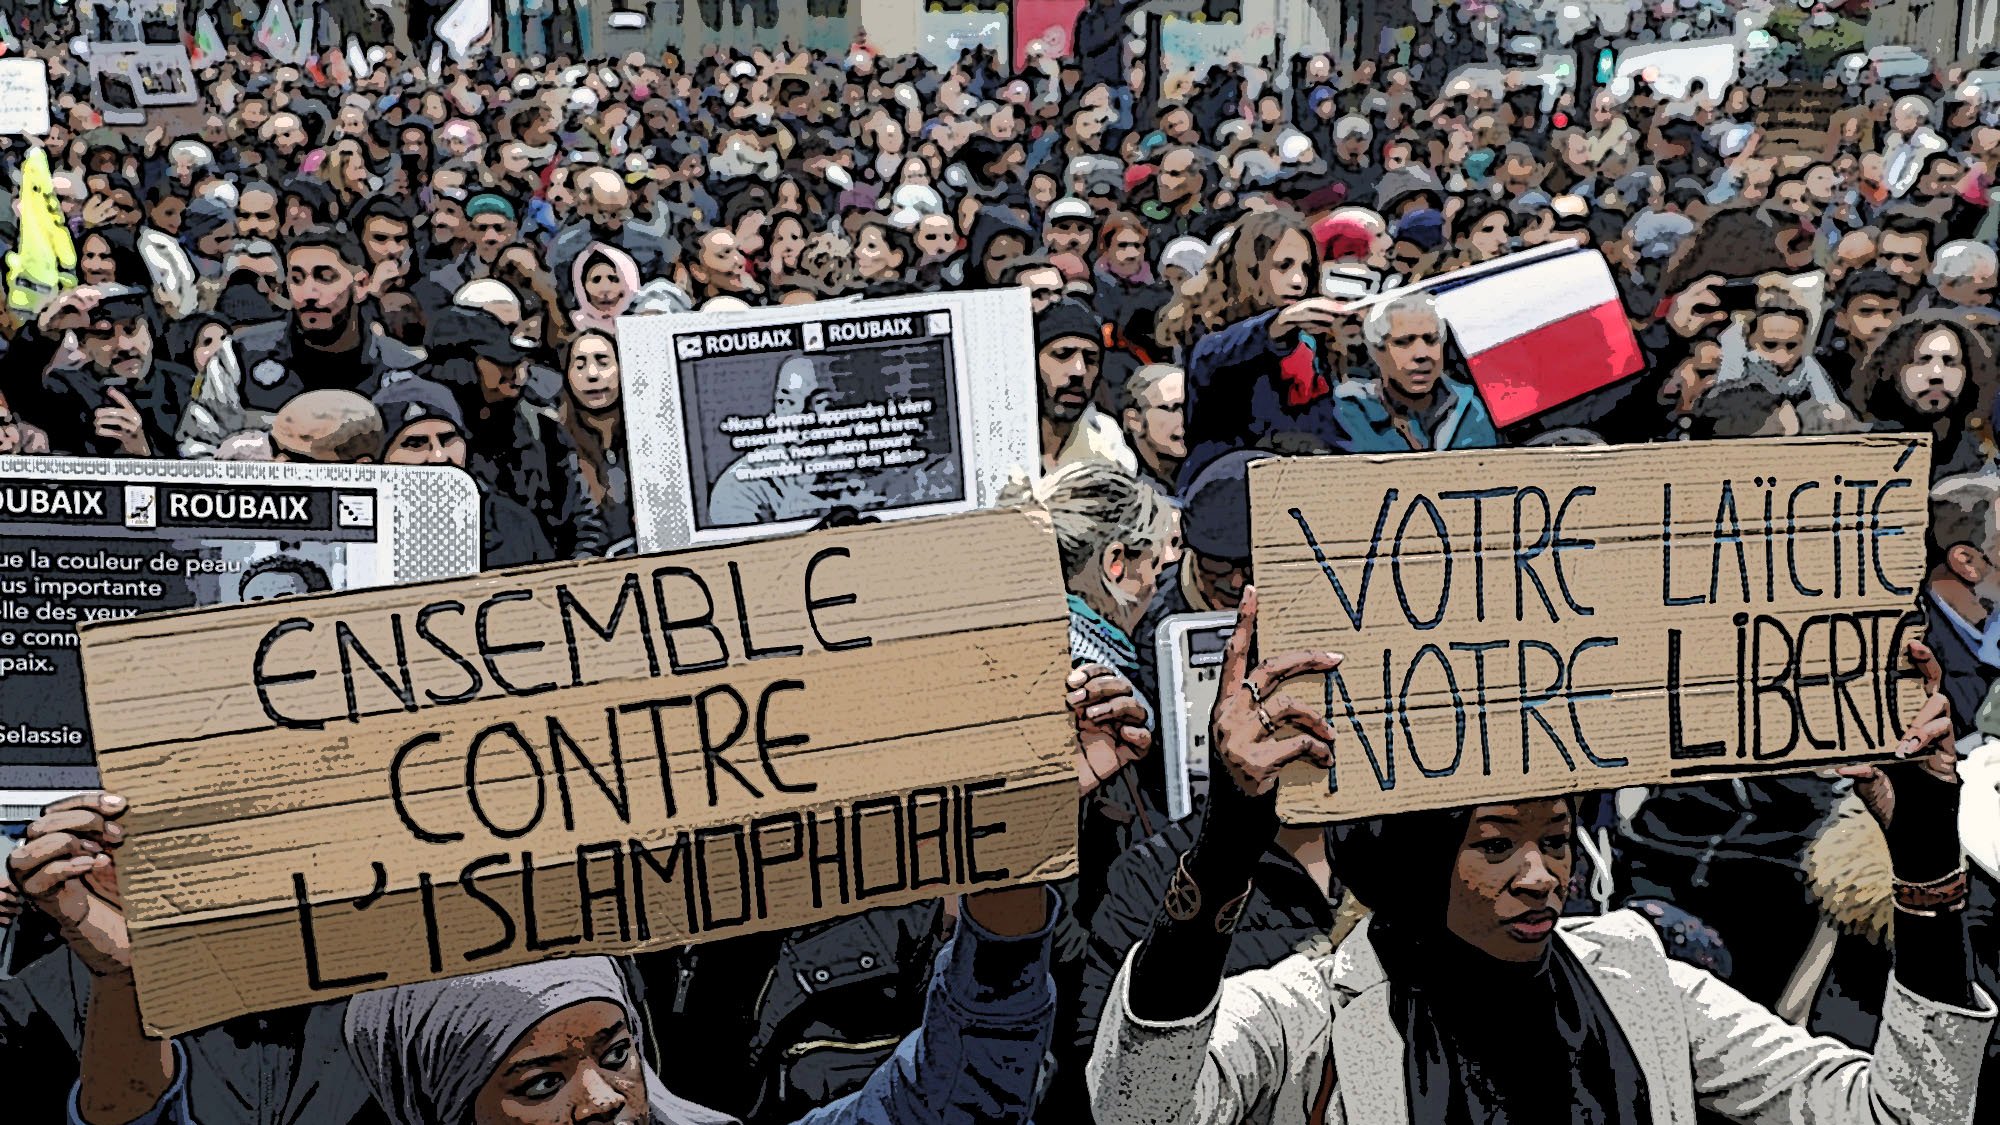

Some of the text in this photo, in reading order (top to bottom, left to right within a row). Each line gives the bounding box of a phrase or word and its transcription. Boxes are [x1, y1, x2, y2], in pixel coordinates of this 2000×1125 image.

[706, 317, 913, 354] ROUBAIX ROUBAIX
[0, 488, 104, 515] UBAIX
[170, 493, 309, 520] ROUBAIX
[31, 548, 50, 568] la
[57, 551, 143, 571] couleur
[149, 551, 180, 571] de
[185, 557, 242, 577] peau
[1287, 485, 1597, 633] VOTRE
[34, 575, 163, 600] importante
[36, 601, 77, 620] des
[252, 546, 874, 731] ENSEMBLE
[0, 652, 55, 677] paix.
[1322, 637, 1630, 795] NOTRE
[388, 679, 819, 845] CONTRE
[293, 777, 1010, 992] L'ISLAMOPHOBIE
